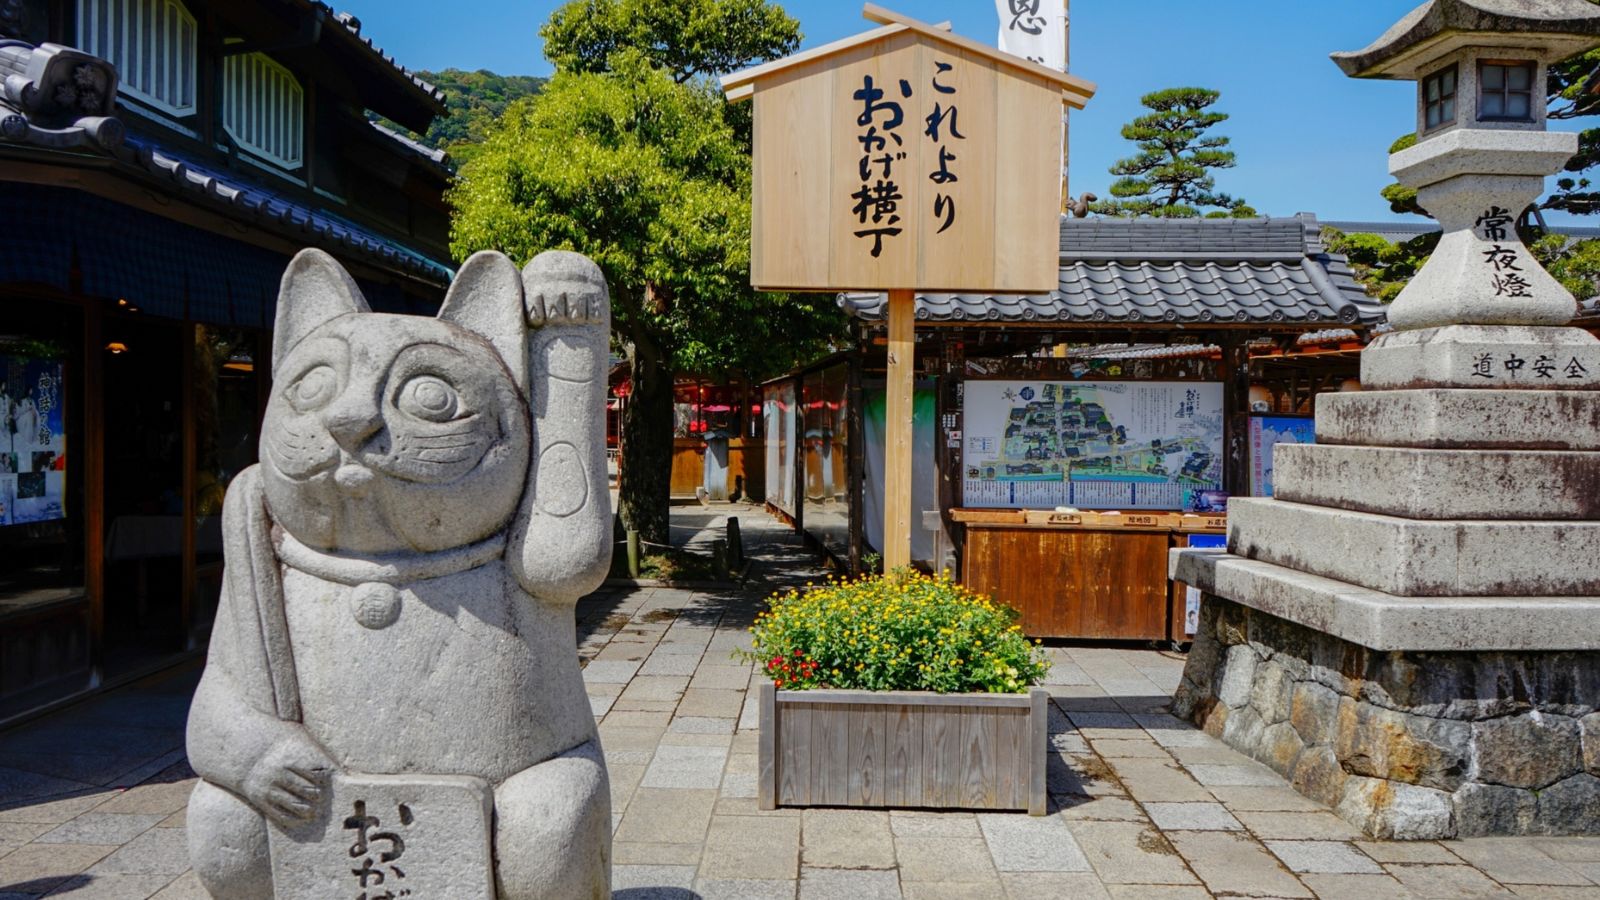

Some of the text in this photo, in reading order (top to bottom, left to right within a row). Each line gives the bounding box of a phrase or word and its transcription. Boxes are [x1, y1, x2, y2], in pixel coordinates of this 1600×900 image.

[851, 75, 913, 258] おかげ横丁
[925, 61, 966, 234] これより
[1475, 206, 1533, 298] 常夜燈
[1472, 352, 1587, 379] 道中安全
